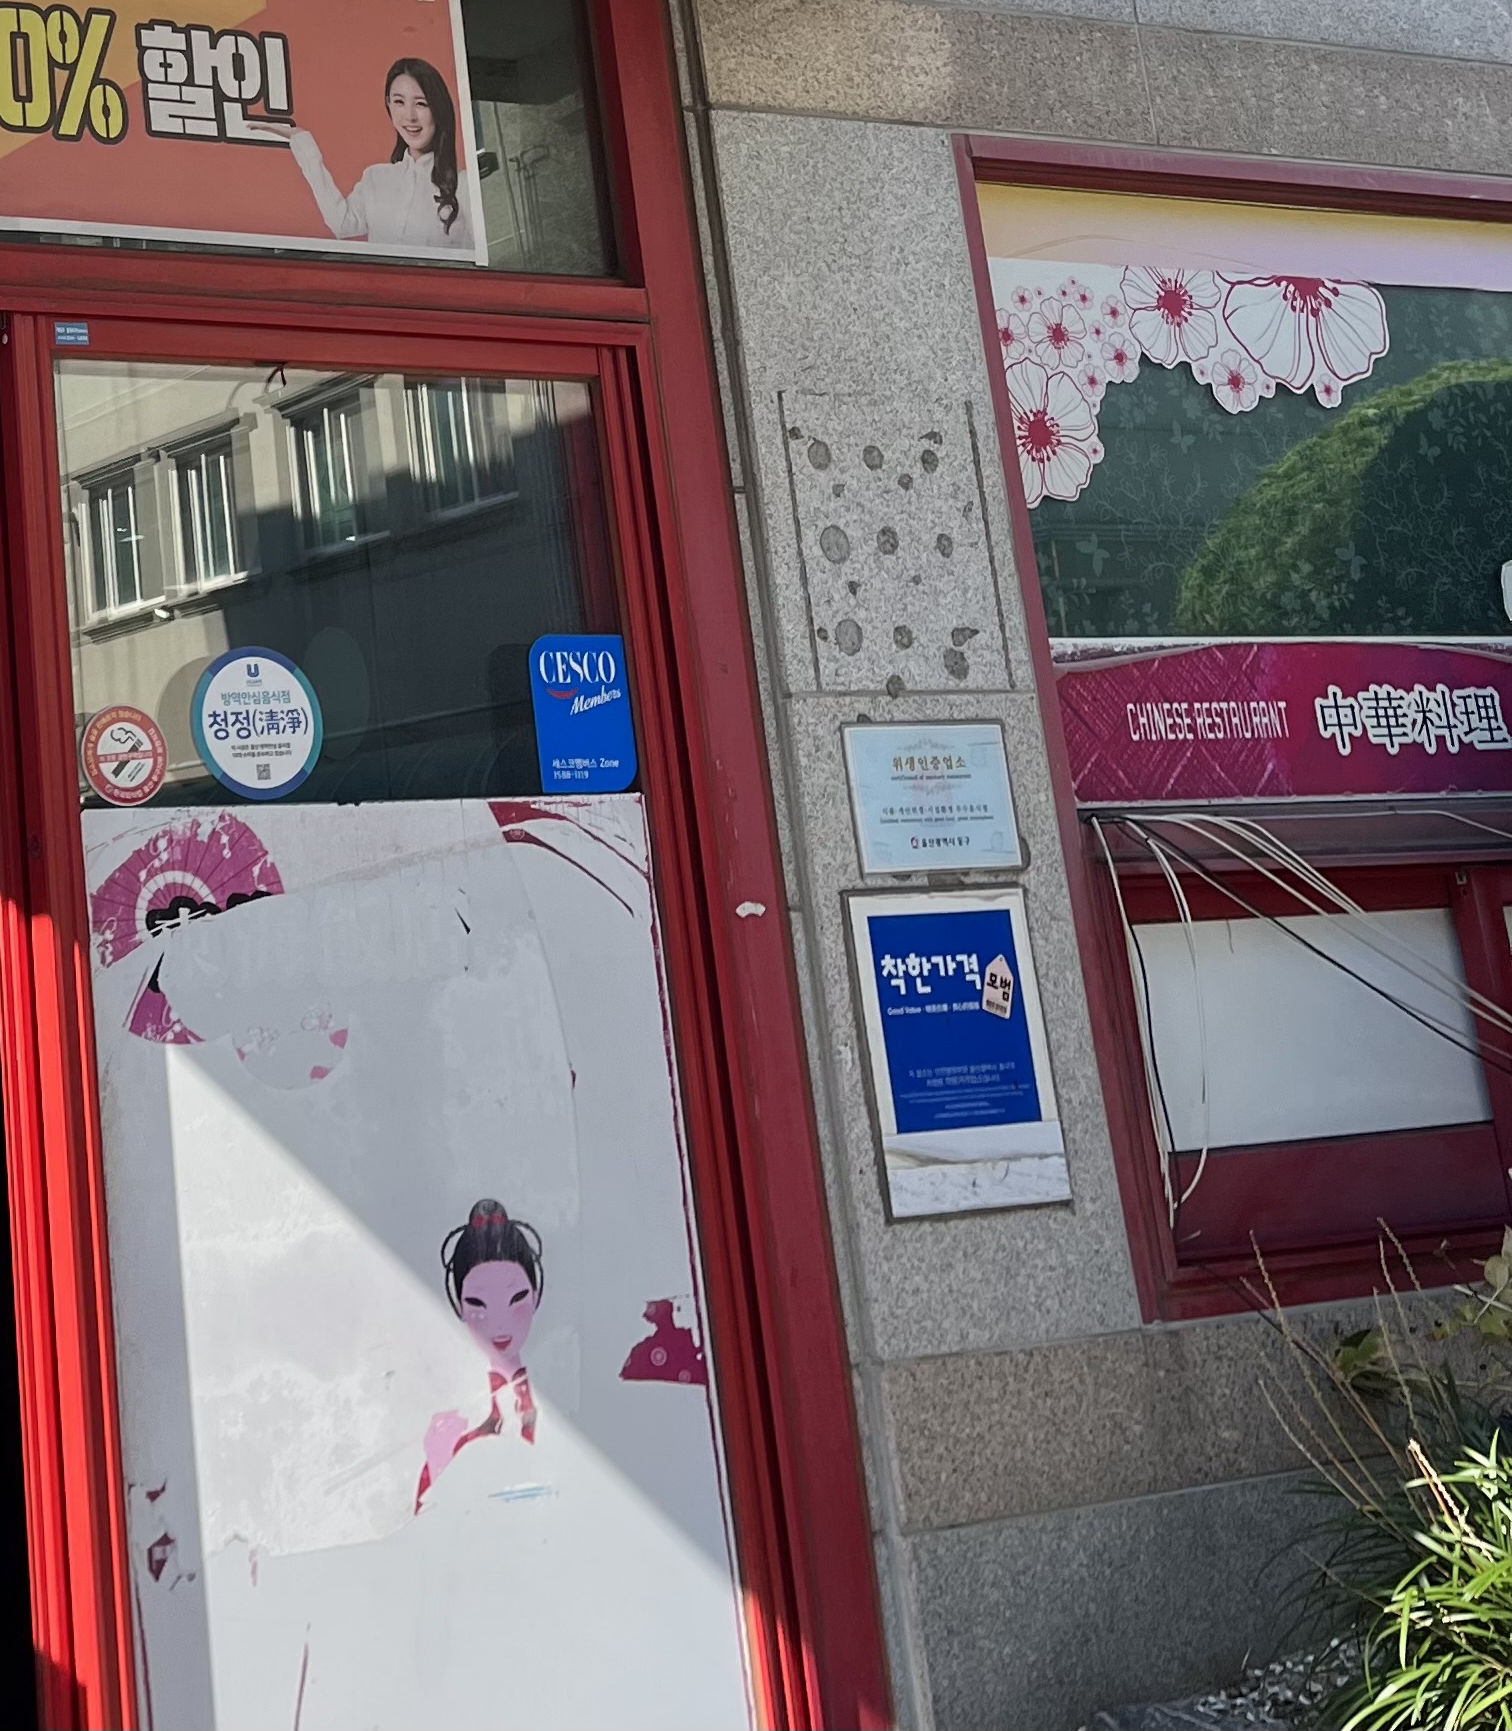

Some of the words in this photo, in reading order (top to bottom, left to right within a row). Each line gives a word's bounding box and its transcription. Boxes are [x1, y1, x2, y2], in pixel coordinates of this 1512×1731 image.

[137, 20, 294, 145] 할인
[539, 650, 616, 684] CESCO
[220, 689, 292, 706] 방역안심음식점
[569, 684, 622, 716] Members
[1126, 702, 1194, 741] CHINESE
[1194, 700, 1290, 740] RESTAURANT
[1316, 683, 1511, 755] 中華料理
[599, 757, 620, 768] Zone
[892, 755, 967, 772] 위생인증업소
[880, 952, 982, 996] 착한가격
[986, 971, 1012, 1002] 모범
